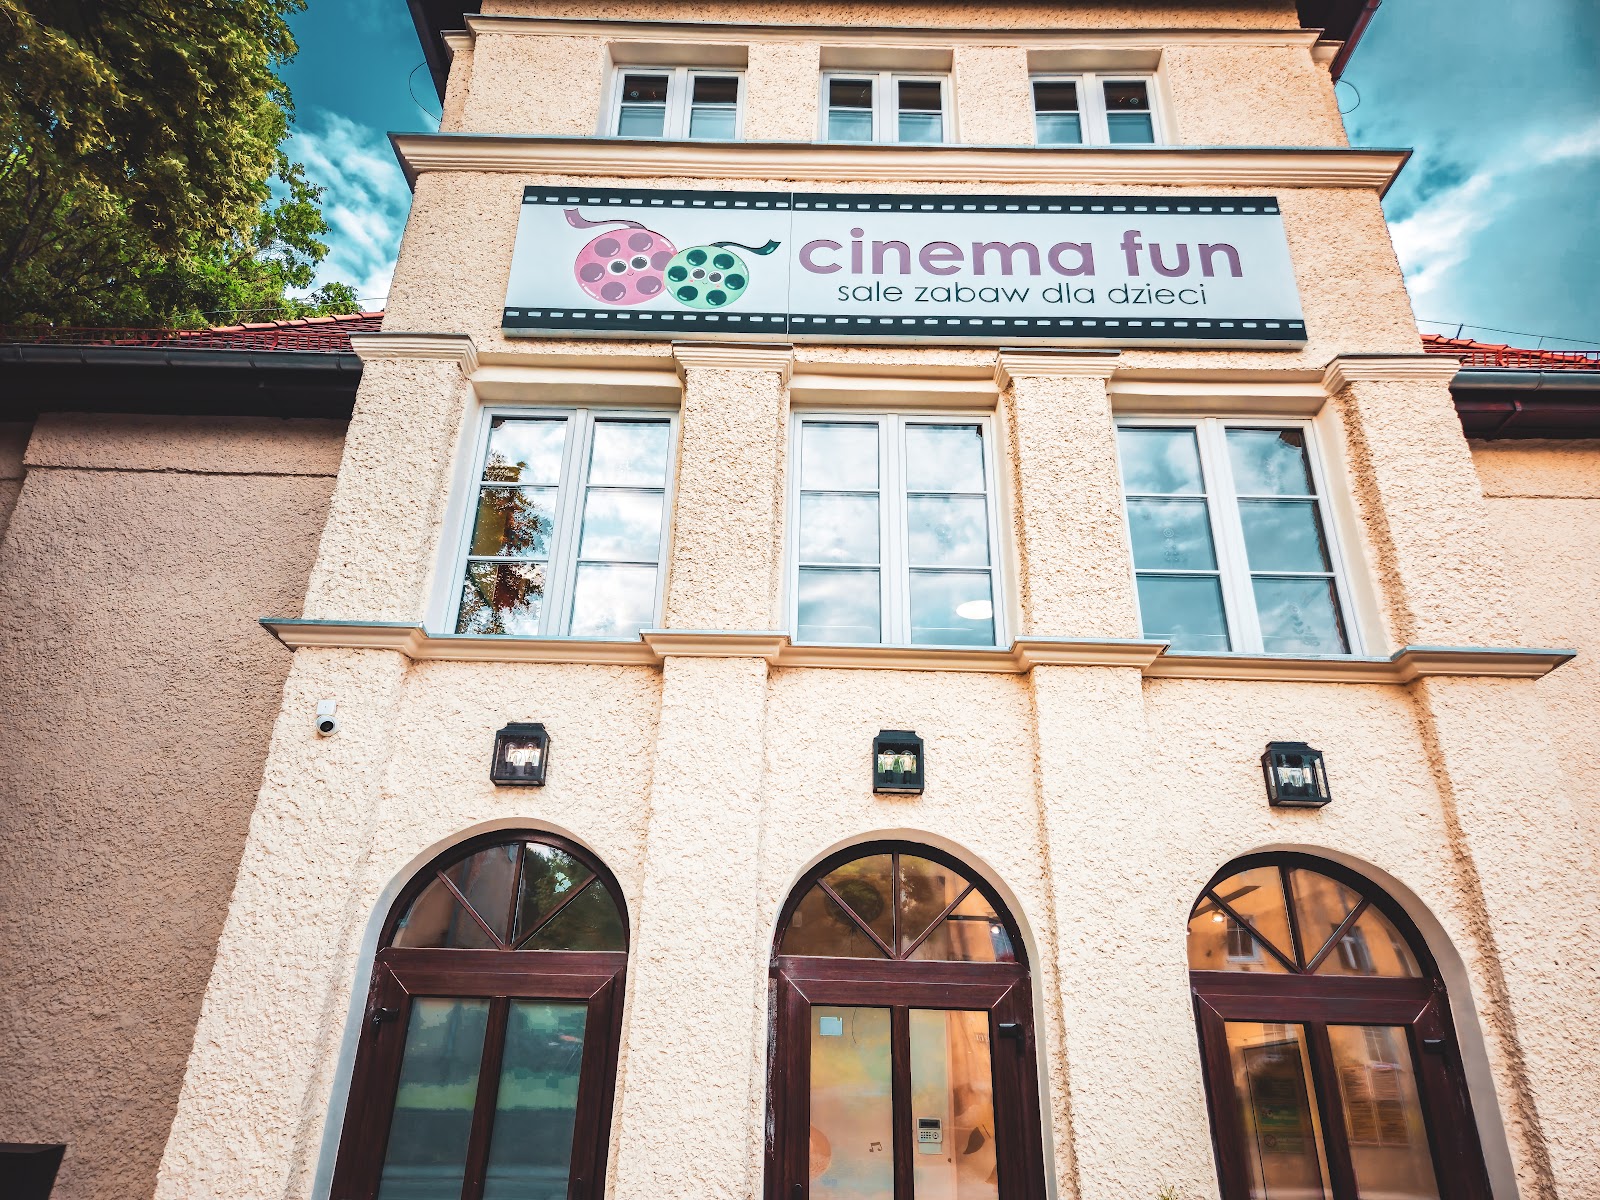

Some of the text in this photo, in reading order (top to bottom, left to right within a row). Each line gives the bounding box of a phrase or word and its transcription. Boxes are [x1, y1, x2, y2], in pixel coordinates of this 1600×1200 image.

[799, 228, 1244, 278] cinema fun
[837, 281, 1207, 305] sale zabaw dla dzieci
